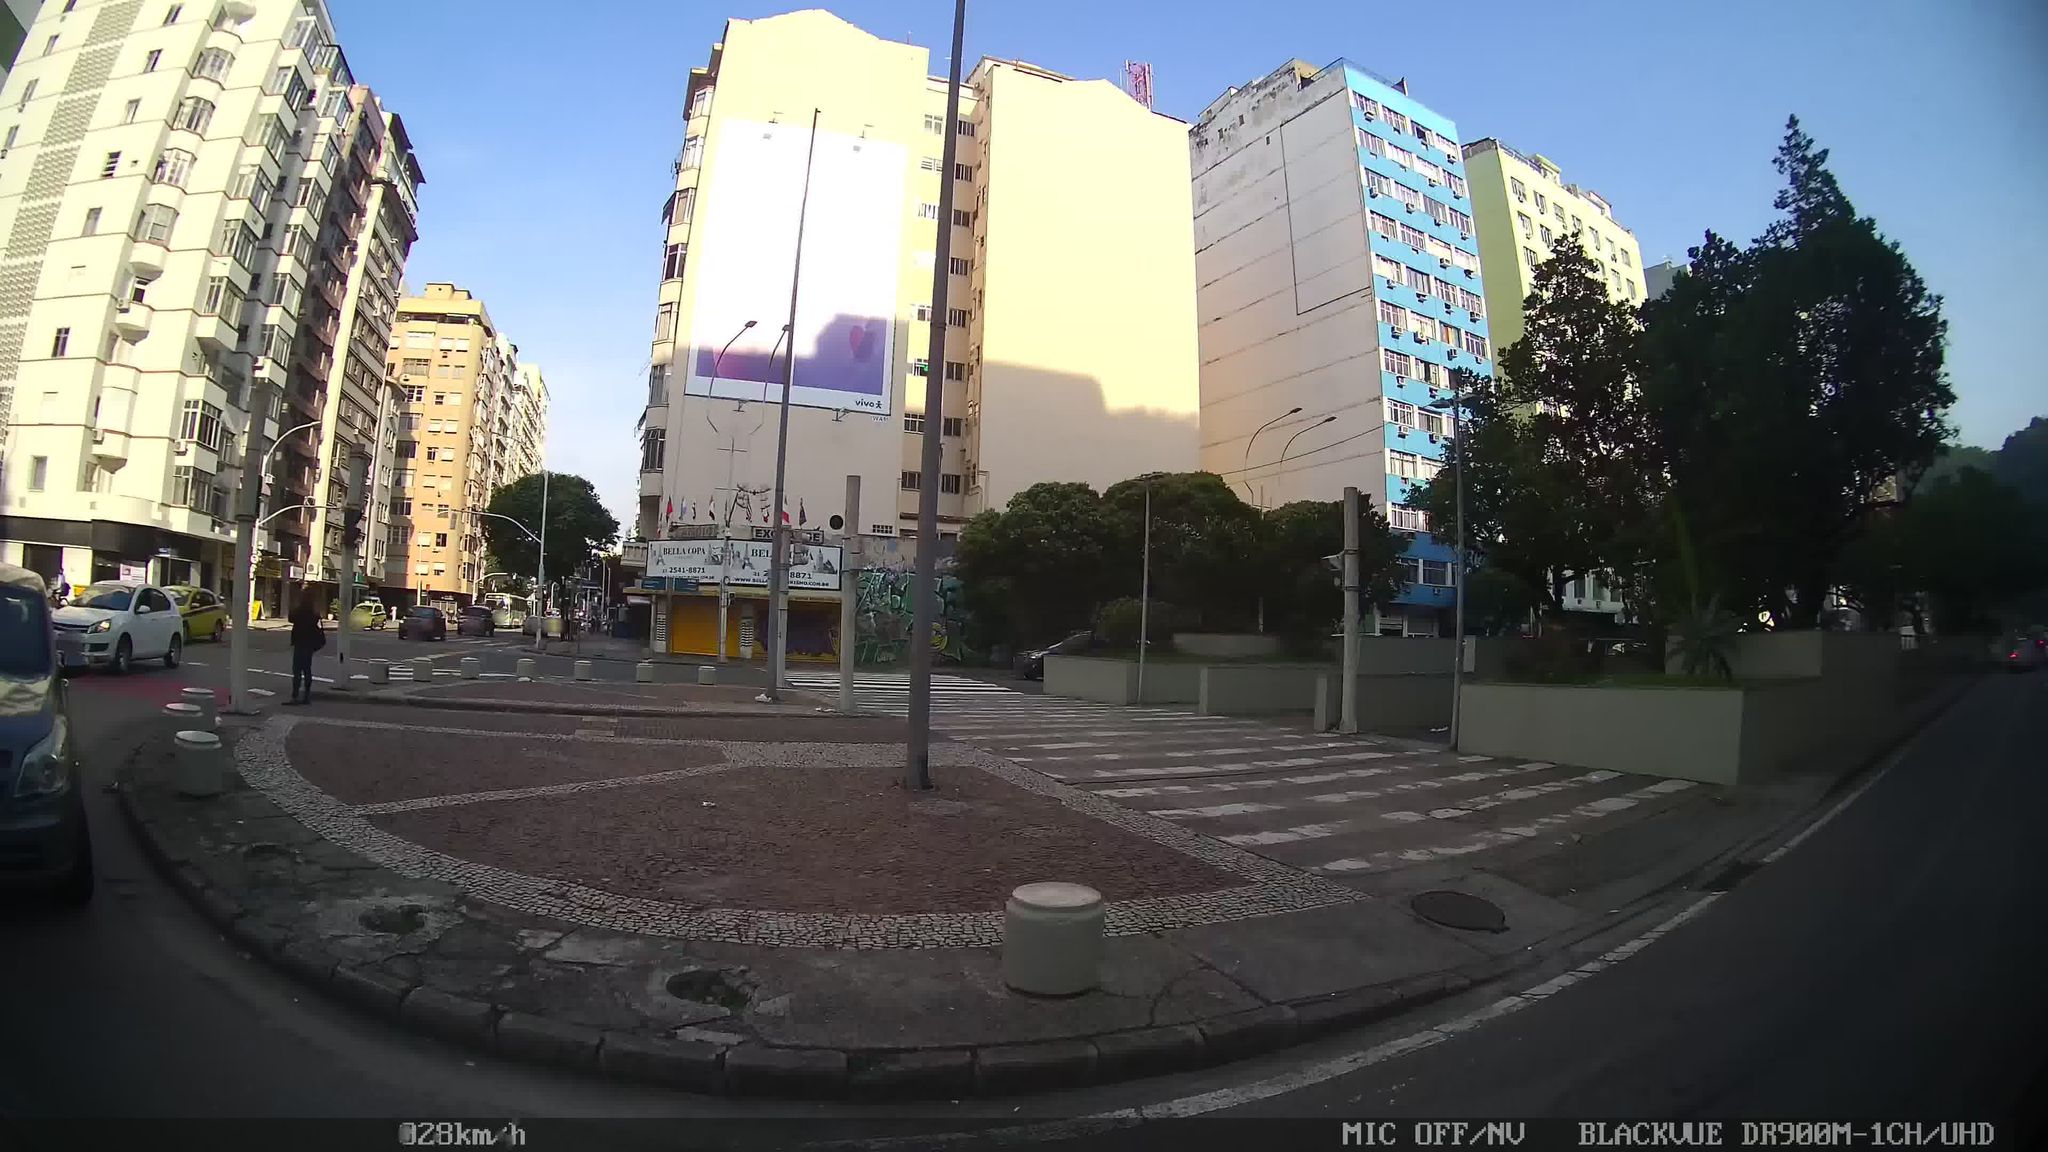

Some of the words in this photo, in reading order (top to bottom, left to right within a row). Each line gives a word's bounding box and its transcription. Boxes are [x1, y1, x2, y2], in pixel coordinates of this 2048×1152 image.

[855, 398, 875, 408] vivo
[663, 547, 685, 555] BELLA
[688, 547, 706, 555] COPA
